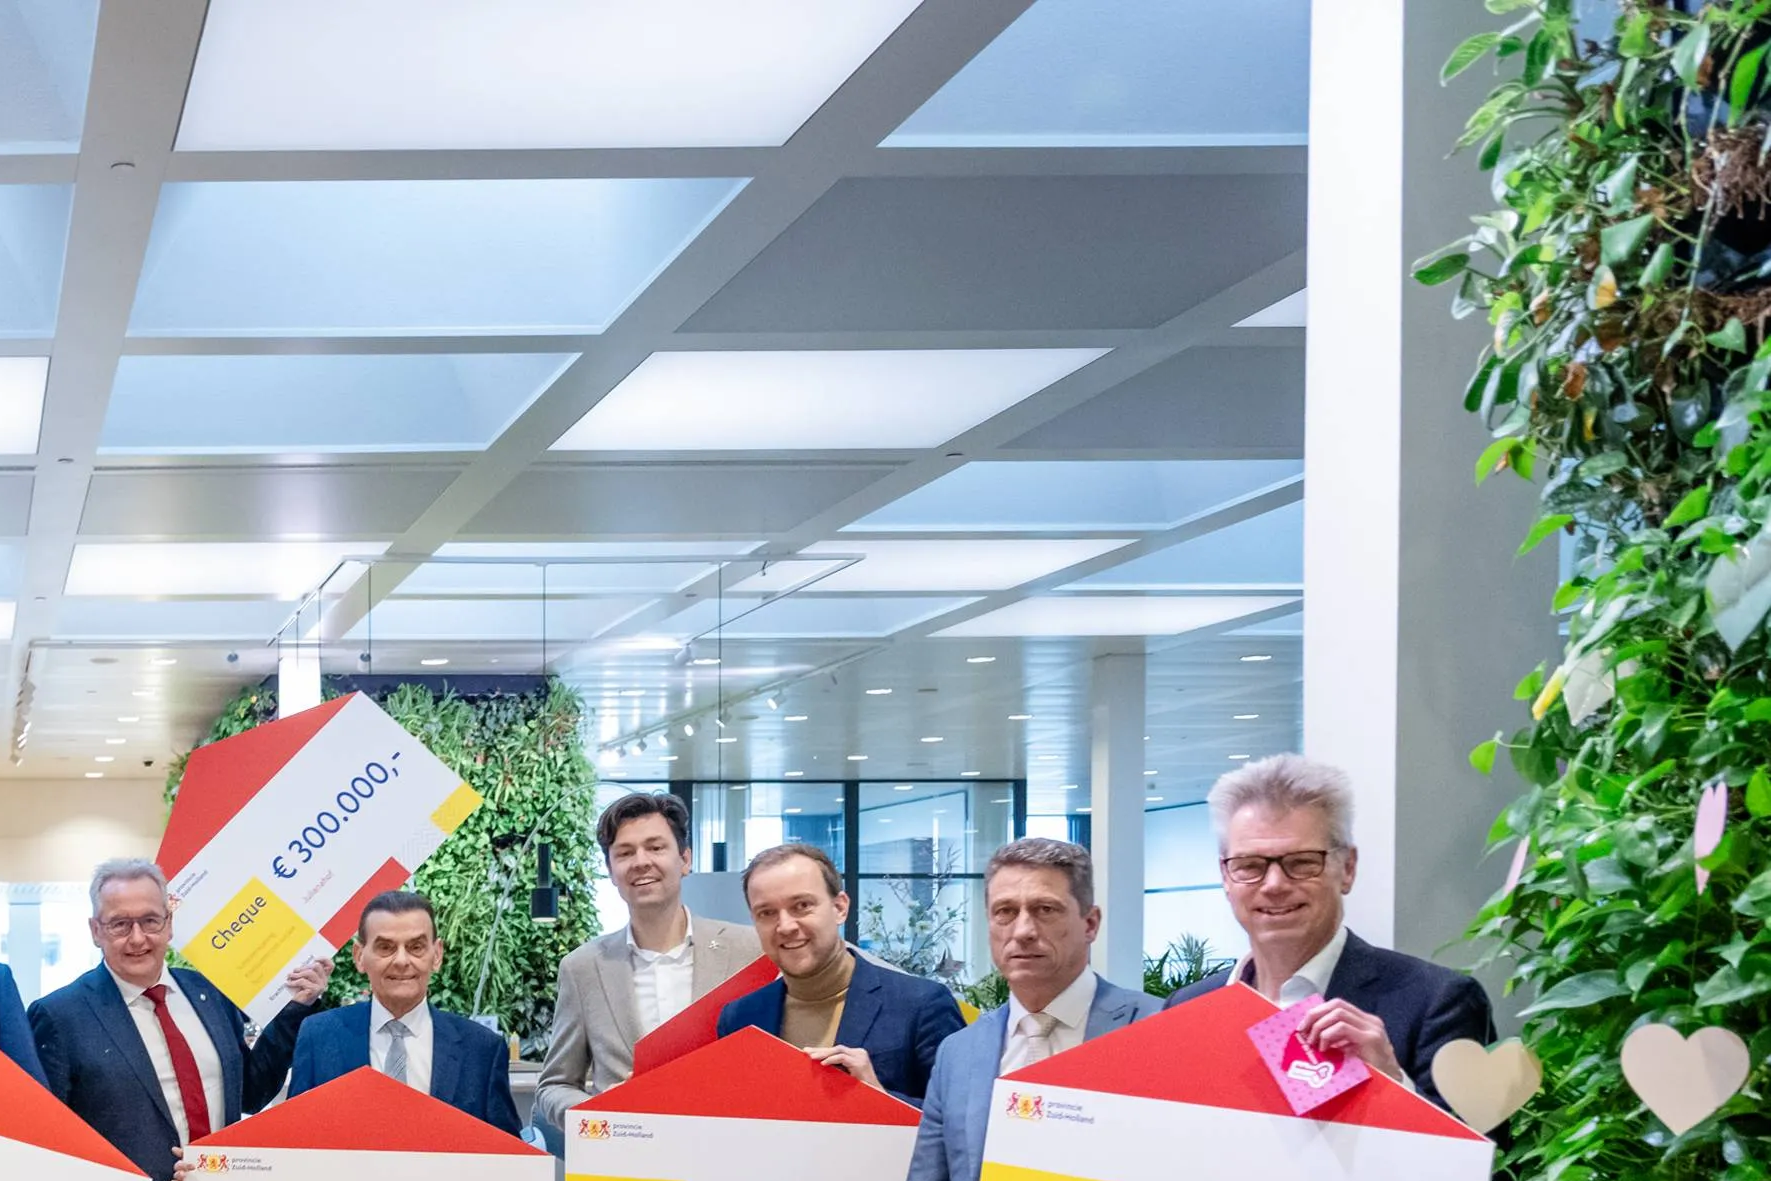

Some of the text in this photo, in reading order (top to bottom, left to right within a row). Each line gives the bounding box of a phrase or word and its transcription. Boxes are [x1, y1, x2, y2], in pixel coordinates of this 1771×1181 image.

[271, 750, 401, 879] € 300.000,-
[210, 895, 267, 950] Cheque
